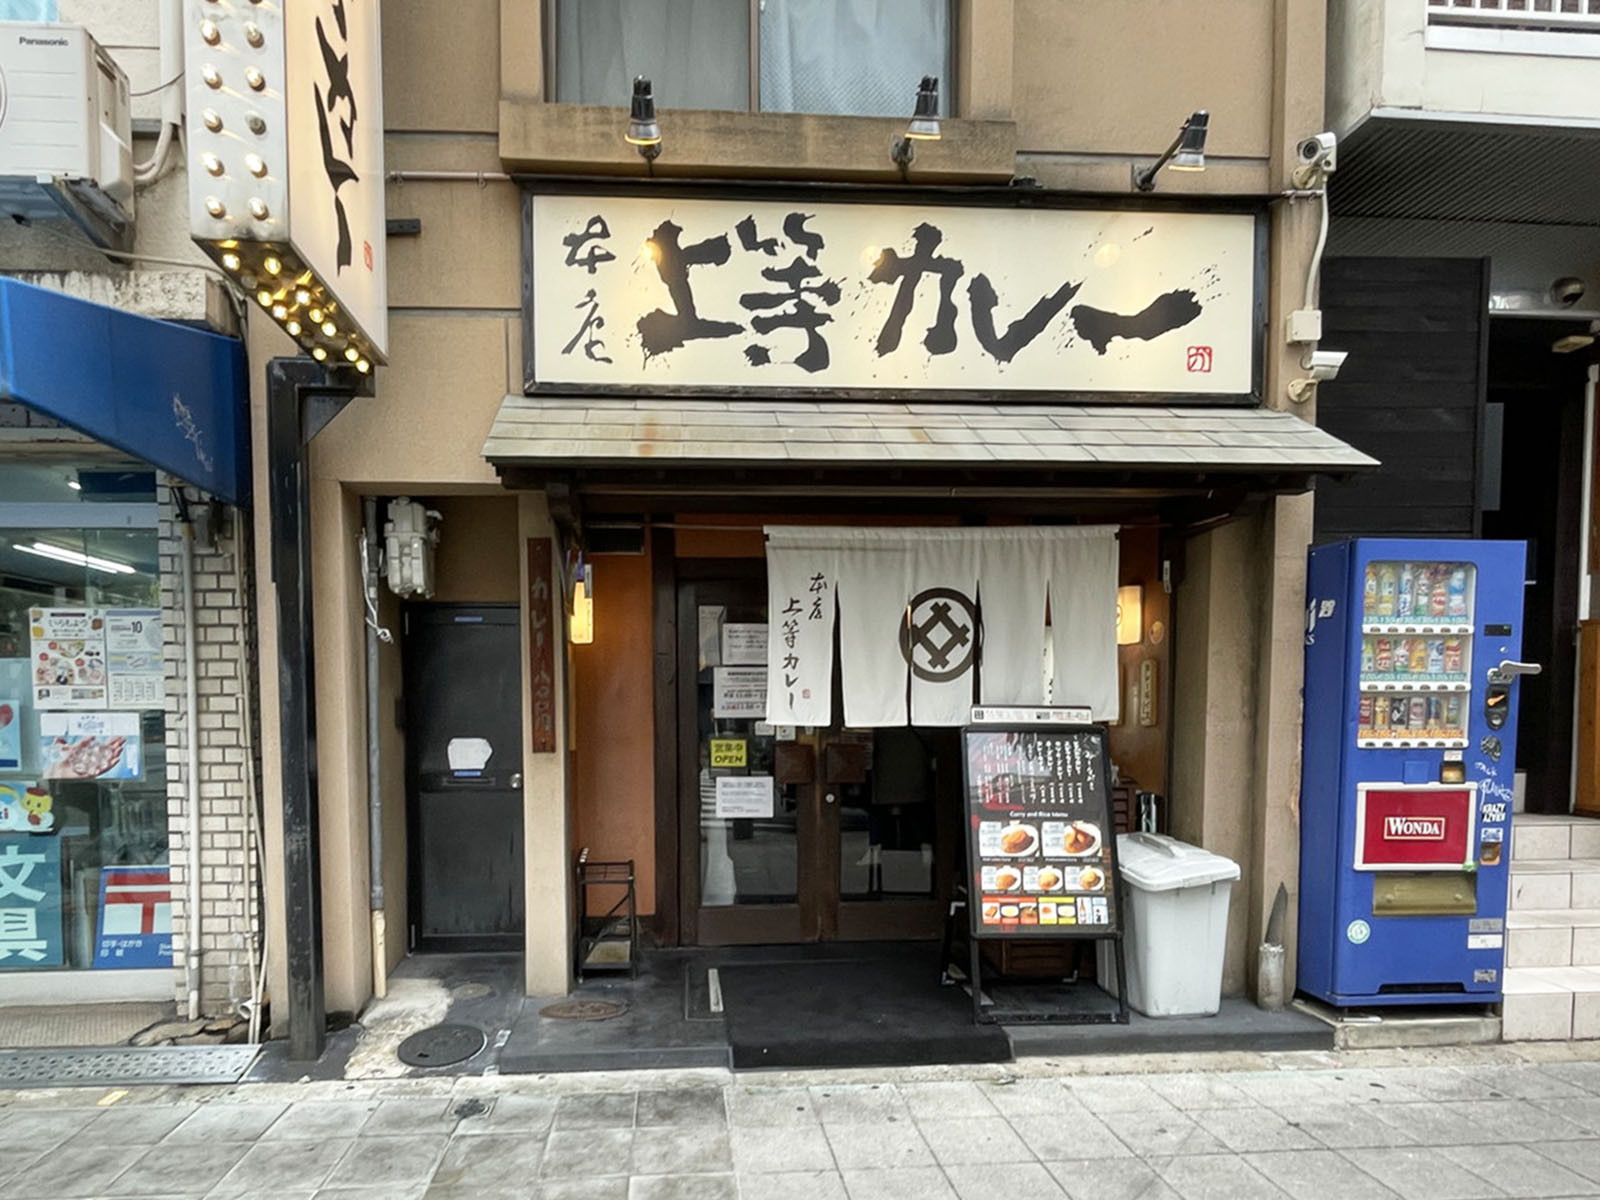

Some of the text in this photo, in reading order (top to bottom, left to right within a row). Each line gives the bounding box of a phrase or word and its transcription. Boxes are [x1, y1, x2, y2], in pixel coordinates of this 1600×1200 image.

[562, 215, 617, 364] 本店
[635, 212, 1206, 374] 上等カレー
[808, 572, 827, 620] 本店
[781, 596, 803, 710] 上等カレー
[714, 755, 743, 764] OPEN
[1389, 817, 1441, 836] WONDA
